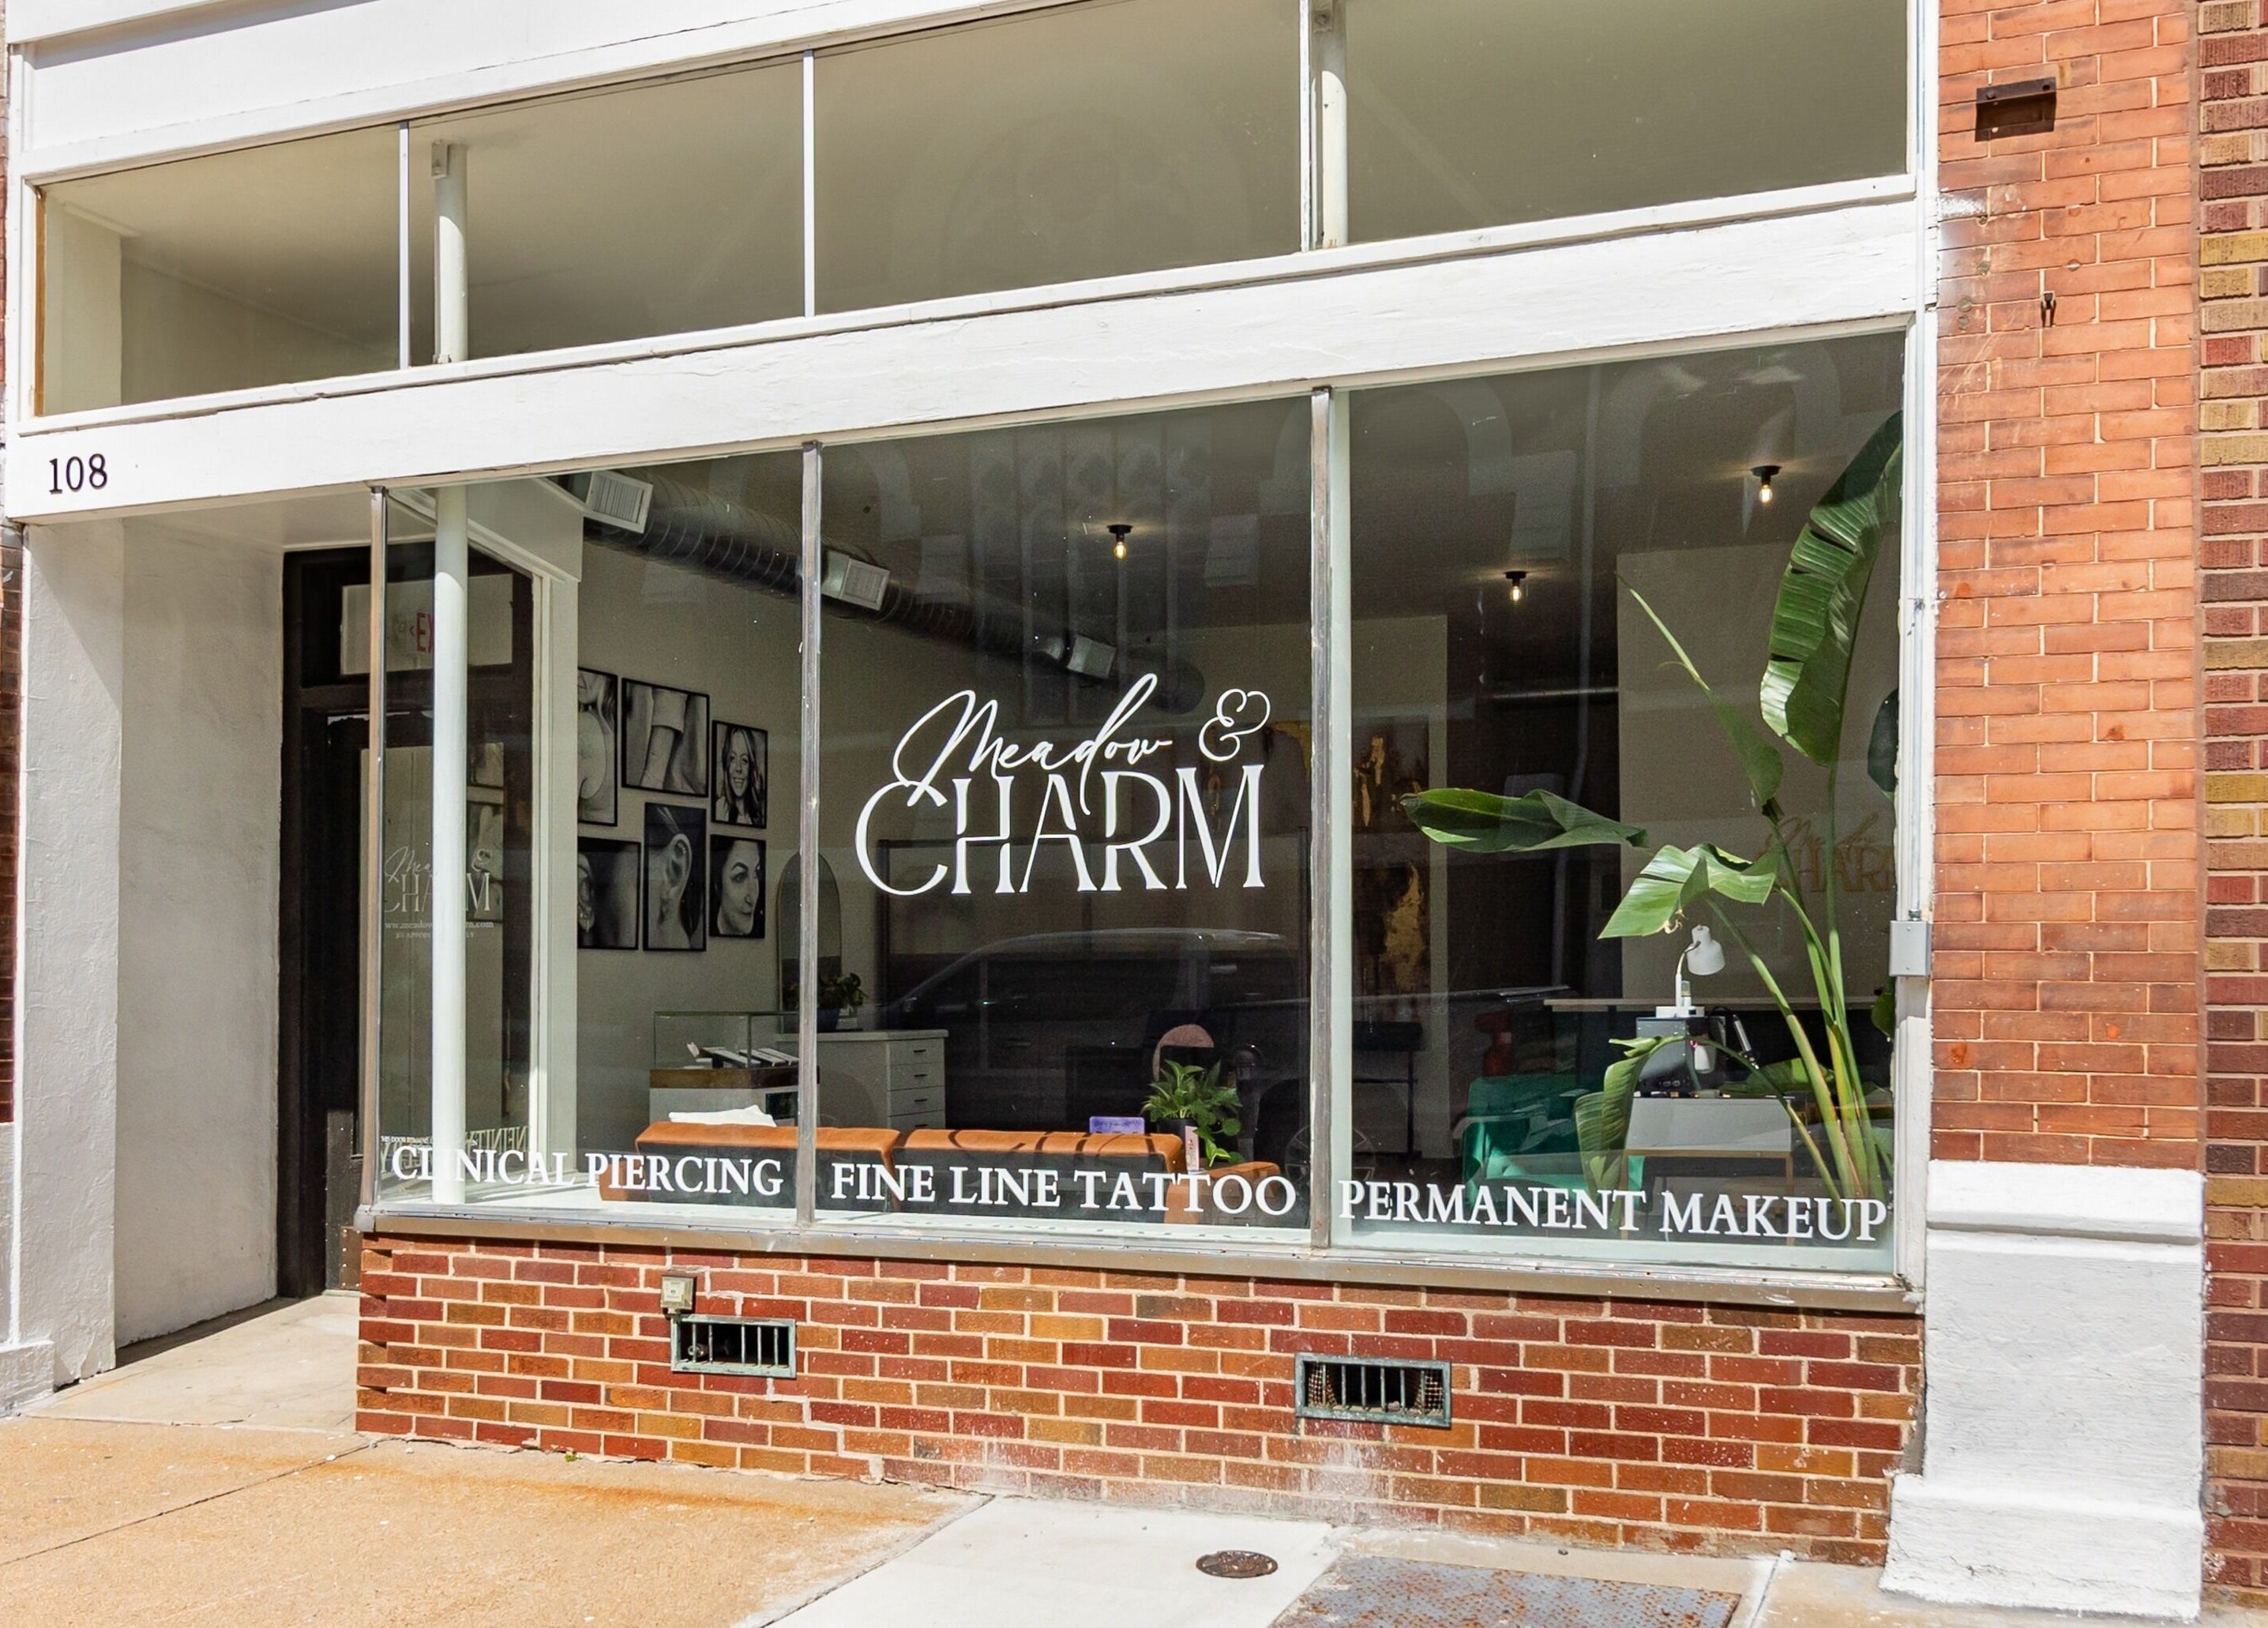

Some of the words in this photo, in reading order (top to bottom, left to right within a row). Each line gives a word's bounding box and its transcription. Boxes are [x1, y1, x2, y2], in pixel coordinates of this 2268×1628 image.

[48, 453, 108, 494] 108
[892, 672, 1173, 816] Meadow
[1198, 688, 1271, 762] &
[854, 763, 1266, 897] CHARM
[584, 1152, 785, 1197] PIERCING
[830, 1162, 937, 1203] FINE
[948, 1165, 1061, 1208] LINE
[1072, 1169, 1297, 1216] TATTOO
[1338, 1179, 1647, 1231] PERMANENT
[1658, 1190, 1887, 1242] MAKEUP
